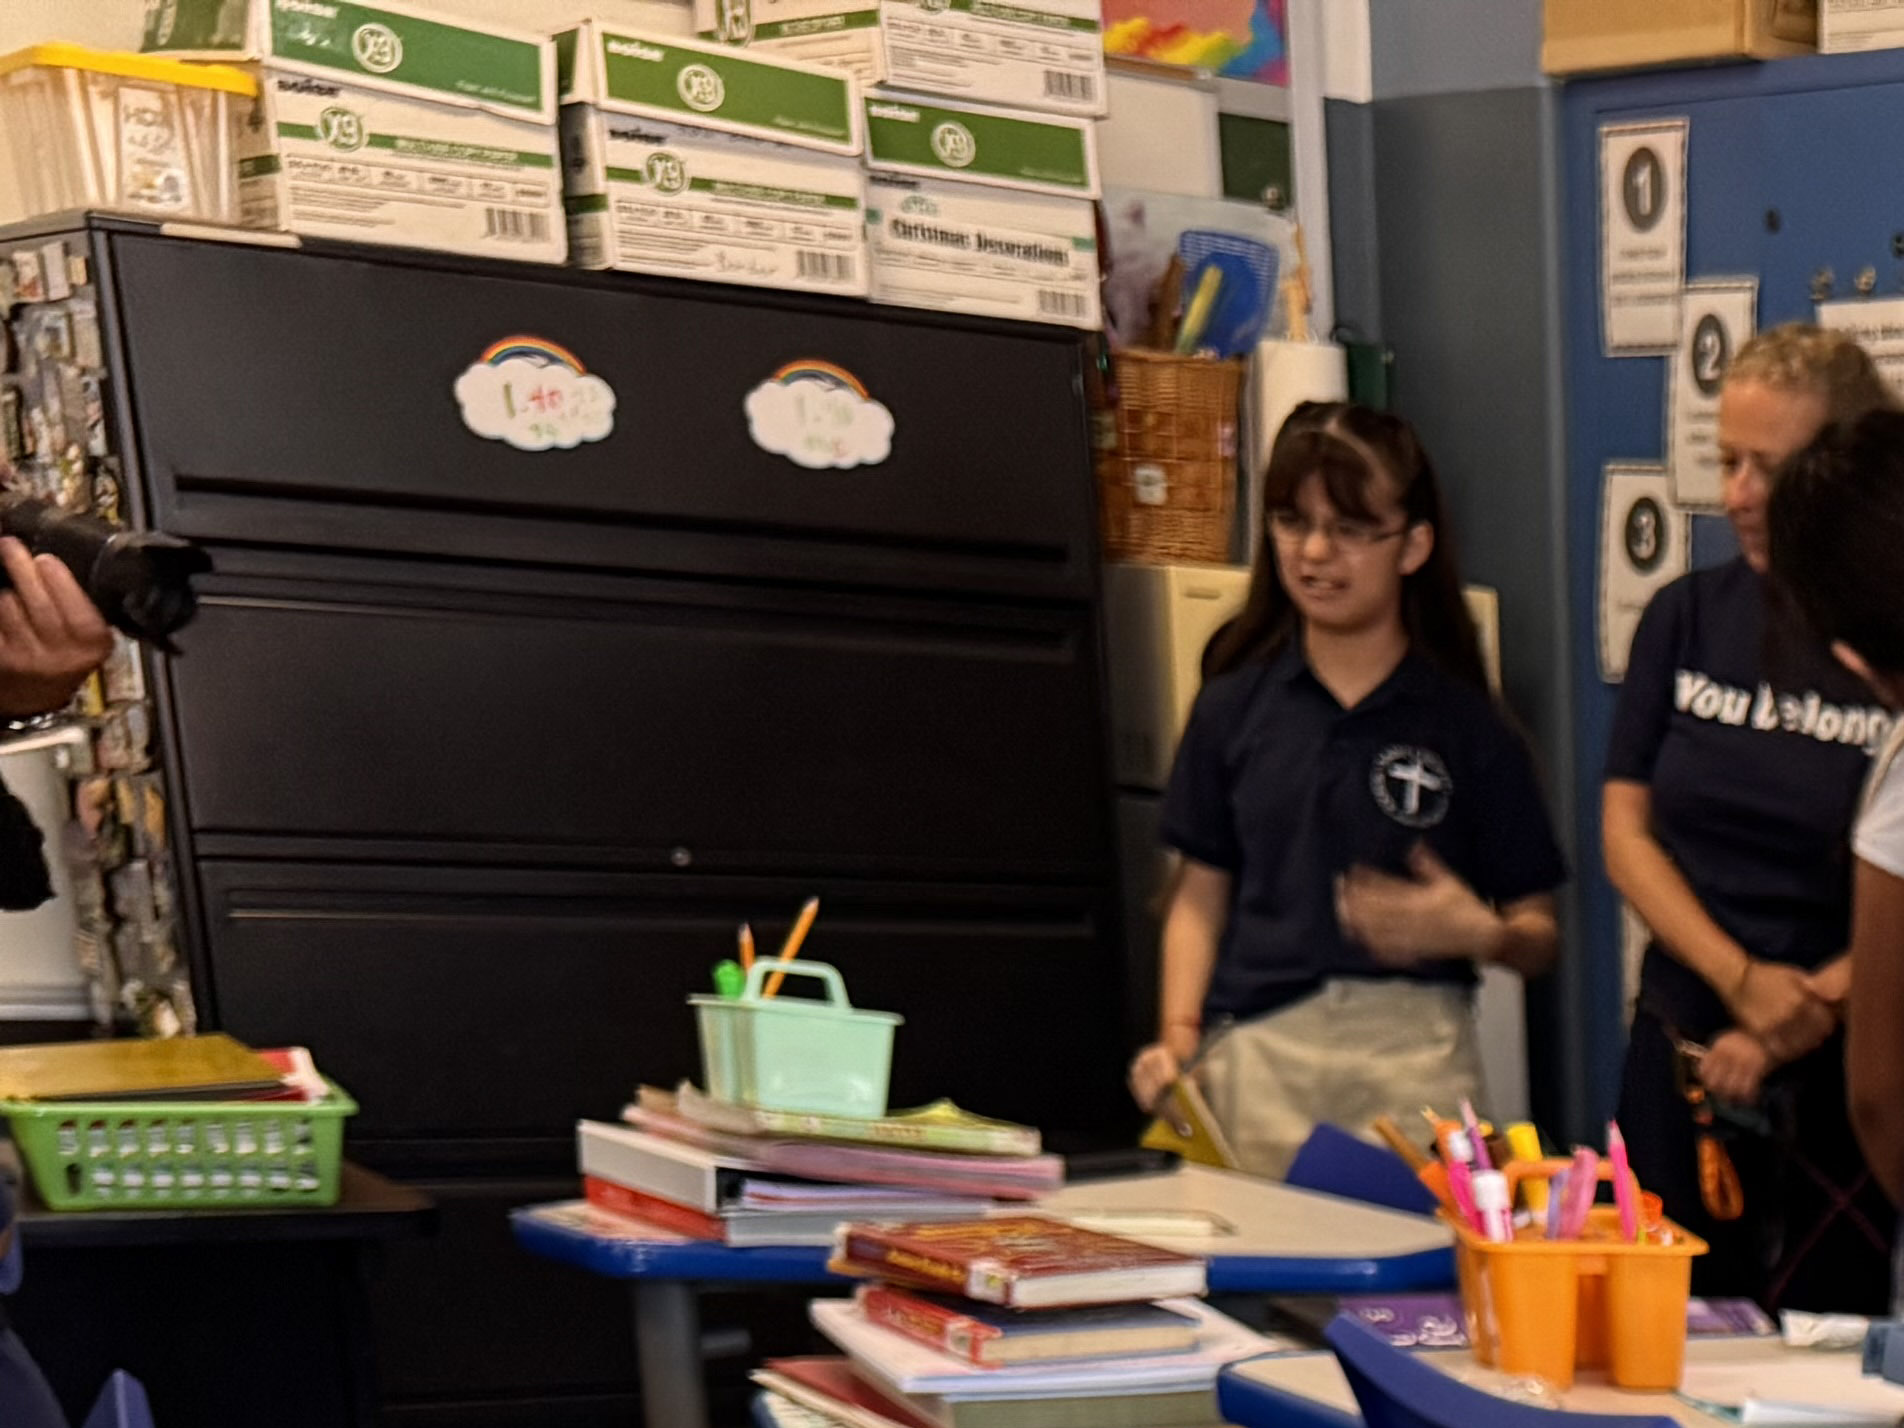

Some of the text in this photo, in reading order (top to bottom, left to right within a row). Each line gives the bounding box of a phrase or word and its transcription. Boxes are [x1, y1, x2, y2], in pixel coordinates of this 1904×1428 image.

[1632, 163, 1652, 218] 1
[1698, 326, 1722, 385] 2
[1634, 506, 1656, 557] 3
[1674, 669, 1751, 727] You
